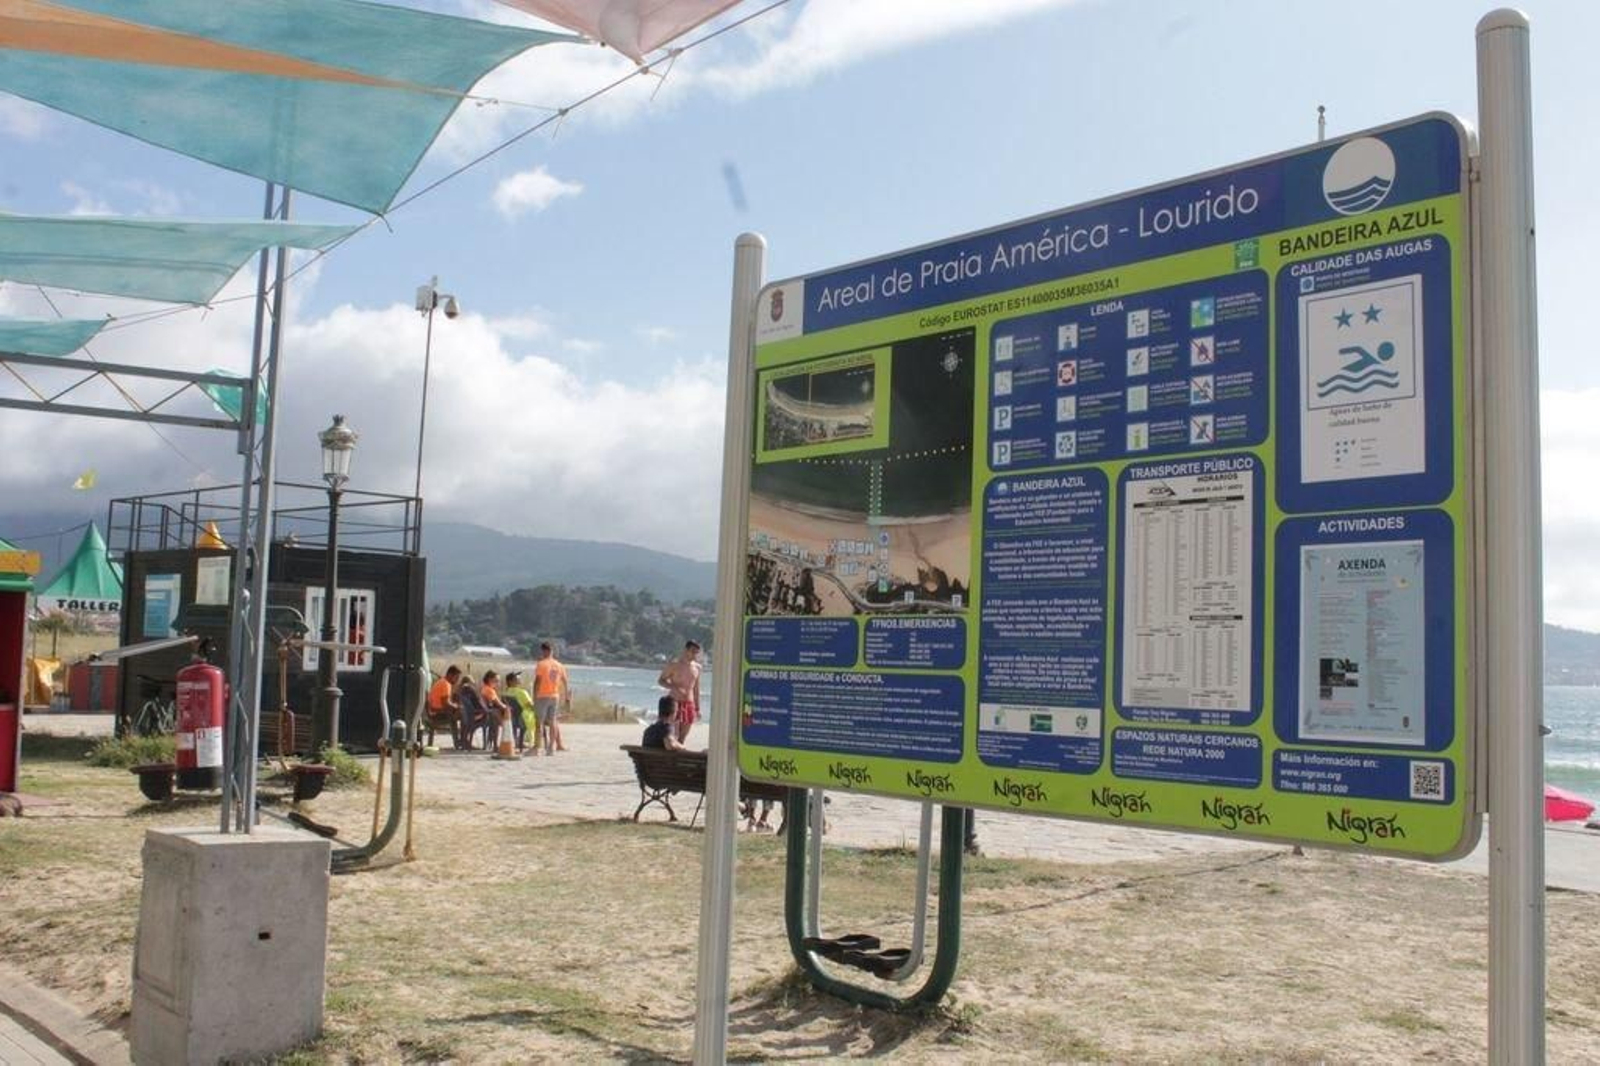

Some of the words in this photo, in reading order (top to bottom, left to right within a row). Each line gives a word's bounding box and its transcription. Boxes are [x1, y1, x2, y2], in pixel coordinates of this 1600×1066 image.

[1279, 219, 1383, 257] BANDEIRA
[1386, 207, 1444, 232] AZUL
[817, 275, 875, 313] Areal
[881, 268, 913, 298] de
[920, 251, 982, 289] Praia
[990, 224, 1109, 273] América
[1139, 185, 1259, 239] Lourido
[1290, 255, 1354, 277] CALIDADE
[1355, 248, 1384, 265] DAS
[1385, 239, 1433, 260] AUGAS
[919, 313, 951, 330] Código
[953, 301, 1004, 323] EUROSTAT
[1090, 300, 1124, 317] LENDA
[998, 408, 1009, 427] P
[1130, 462, 1201, 479] TRANSPORTE
[1203, 457, 1254, 473] PÚBLICO
[1012, 479, 1060, 493] BANDEIRA
[1061, 476, 1087, 488] AZUL
[1318, 516, 1405, 533] ACTIVIDADES
[1338, 558, 1387, 571] AXENDA
[56, 599, 120, 612] TALLER
[750, 670, 778, 681] NORMAS
[779, 671, 790, 681] DE
[790, 672, 834, 683] SEGURIDADE
[1115, 730, 1156, 742] ESPAZOS
[1157, 731, 1203, 745] NATURAIS
[1204, 735, 1258, 749] CERCANOS
[1143, 744, 1166, 755] REDE
[1168, 746, 1204, 759] NATURA
[1205, 749, 1225, 760] 2000
[758, 755, 799, 778] Nigrán
[829, 762, 872, 787] Nigrán
[906, 769, 955, 796] Nigrán
[993, 777, 1048, 807] Nigrán
[1091, 787, 1152, 818] Nigrán
[1202, 797, 1271, 830] Nigrán
[1326, 808, 1406, 844] Nigrán
